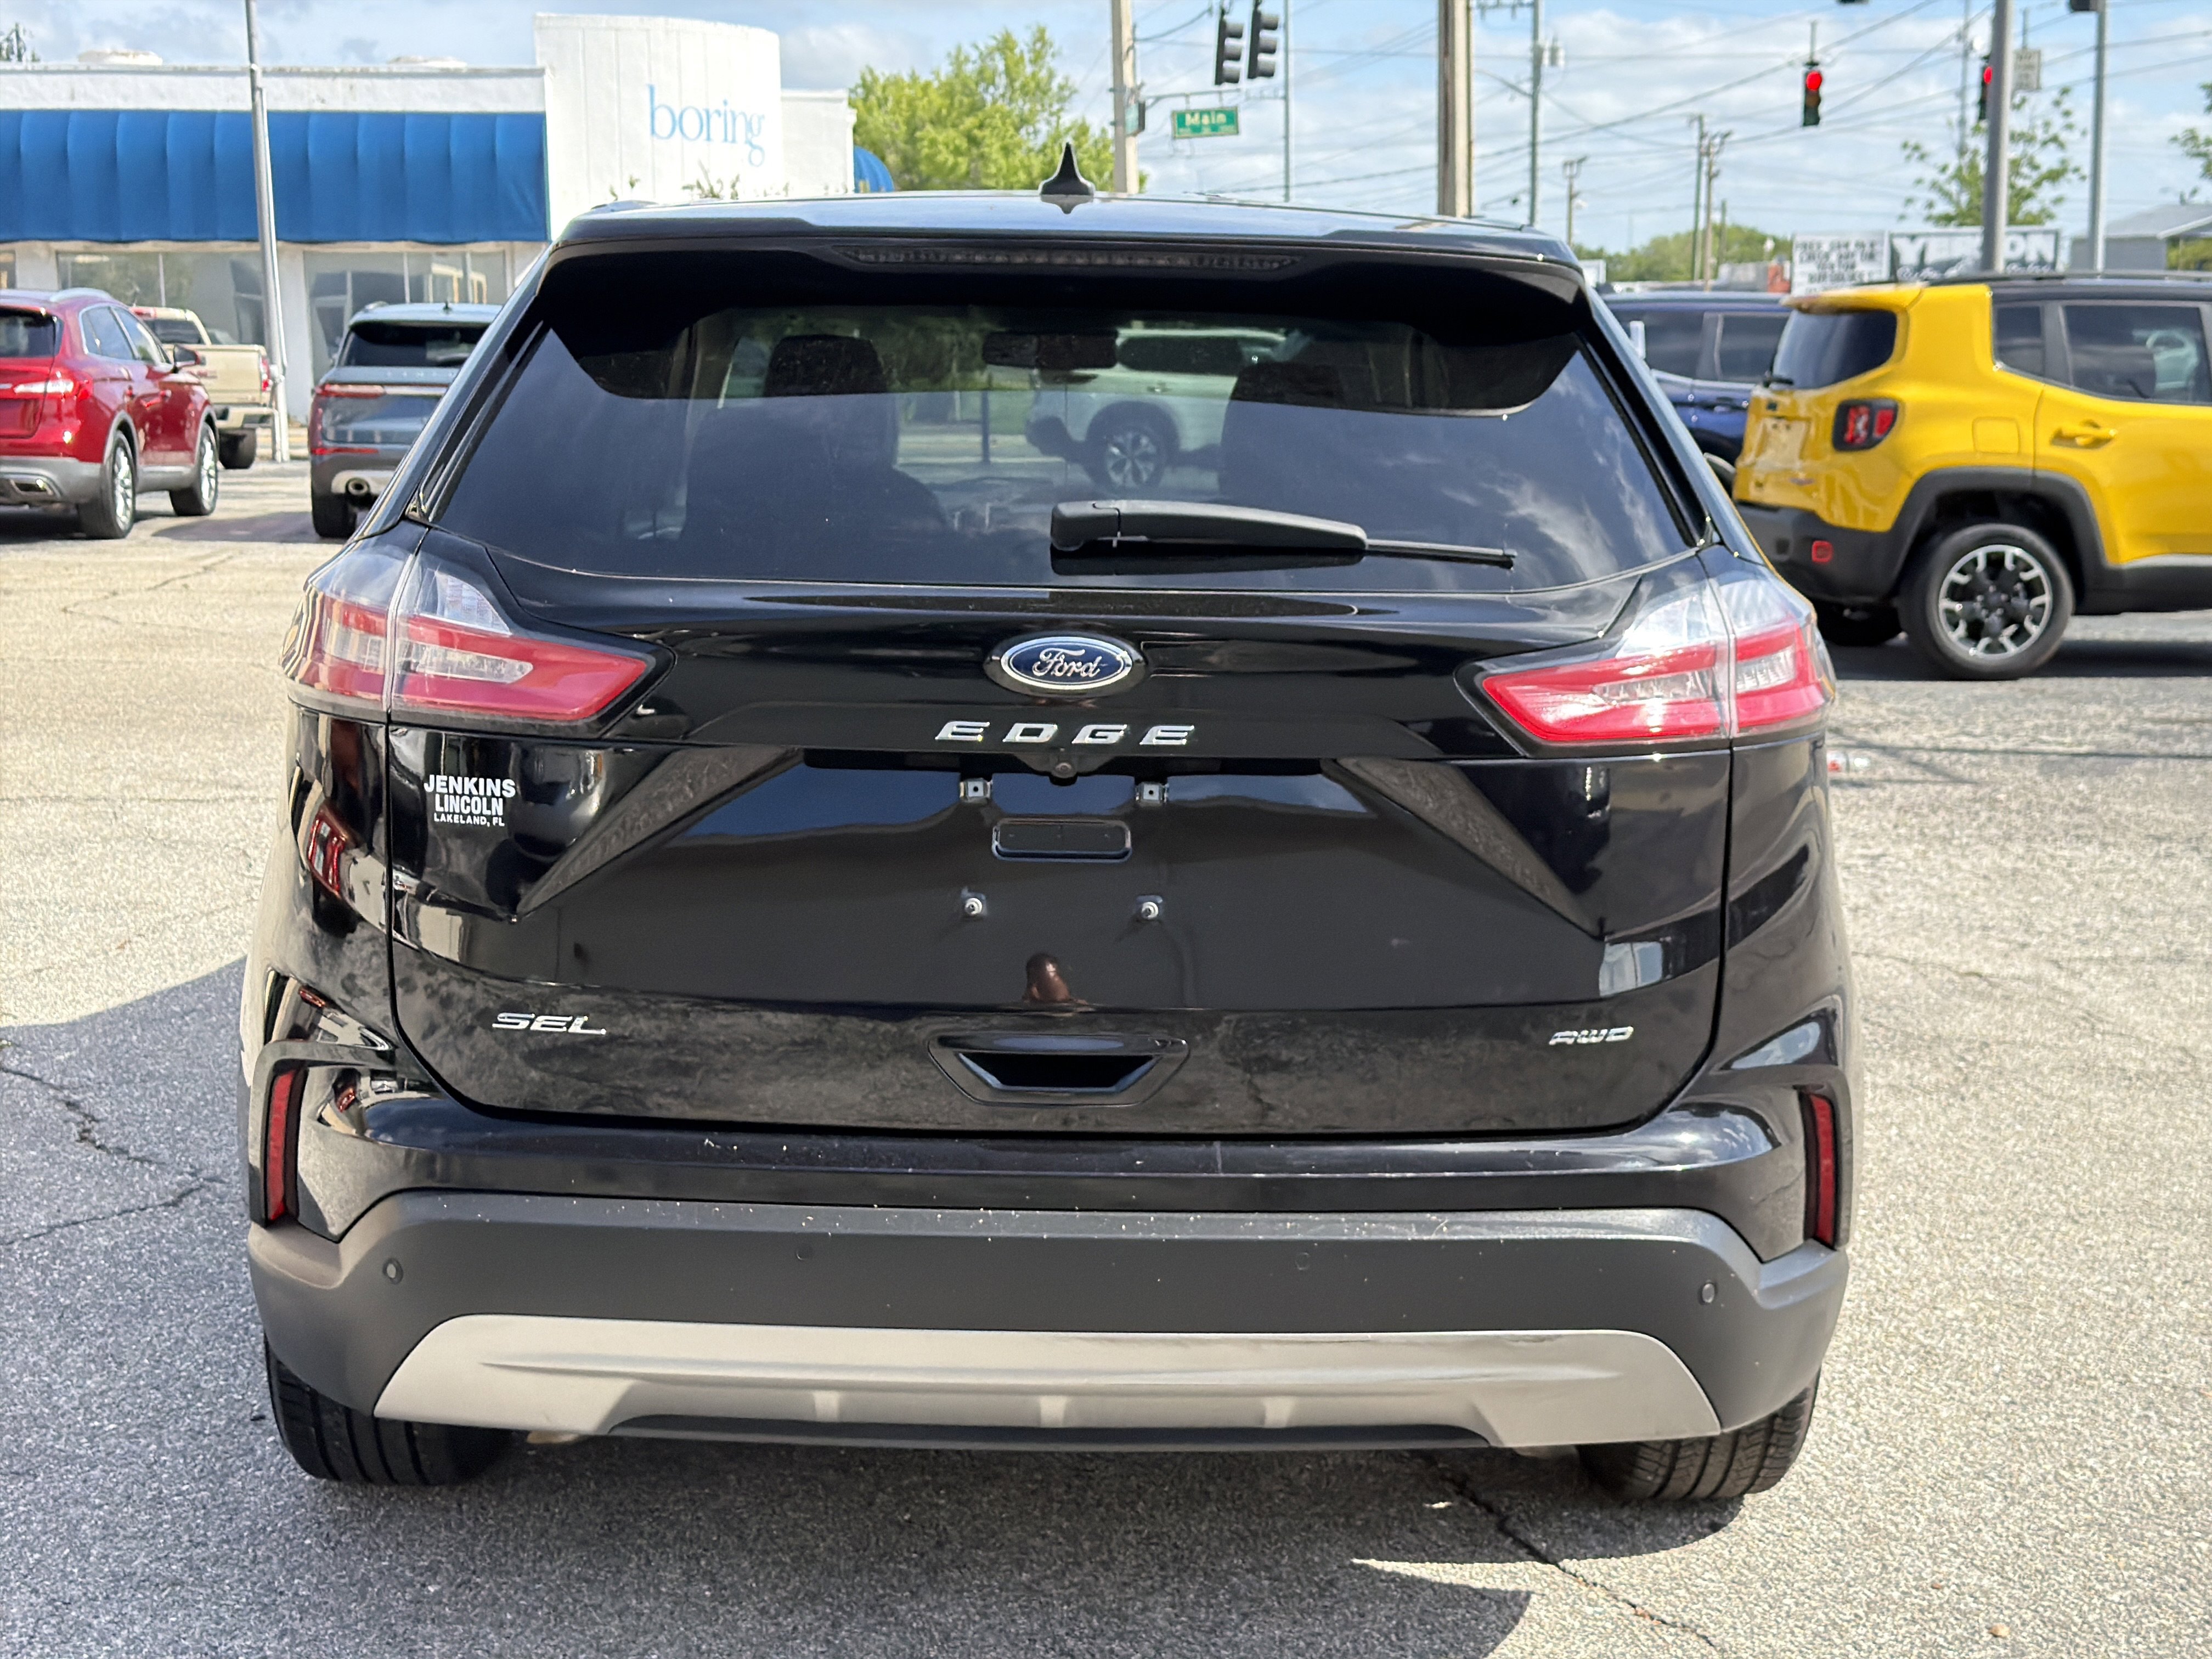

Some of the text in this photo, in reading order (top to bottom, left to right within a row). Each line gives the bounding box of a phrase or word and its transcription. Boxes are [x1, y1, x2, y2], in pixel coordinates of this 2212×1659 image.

[645, 82, 766, 167] boring
[1185, 111, 1227, 126] Main
[1032, 647, 1102, 678] Ford
[935, 720, 1195, 746] EDGE
[424, 774, 516, 798] JENKINS
[435, 793, 504, 816] LINCOLN
[433, 812, 505, 827] LAKELAND, FL
[492, 1012, 607, 1035] SEL
[1548, 1025, 1634, 1046] AWD
